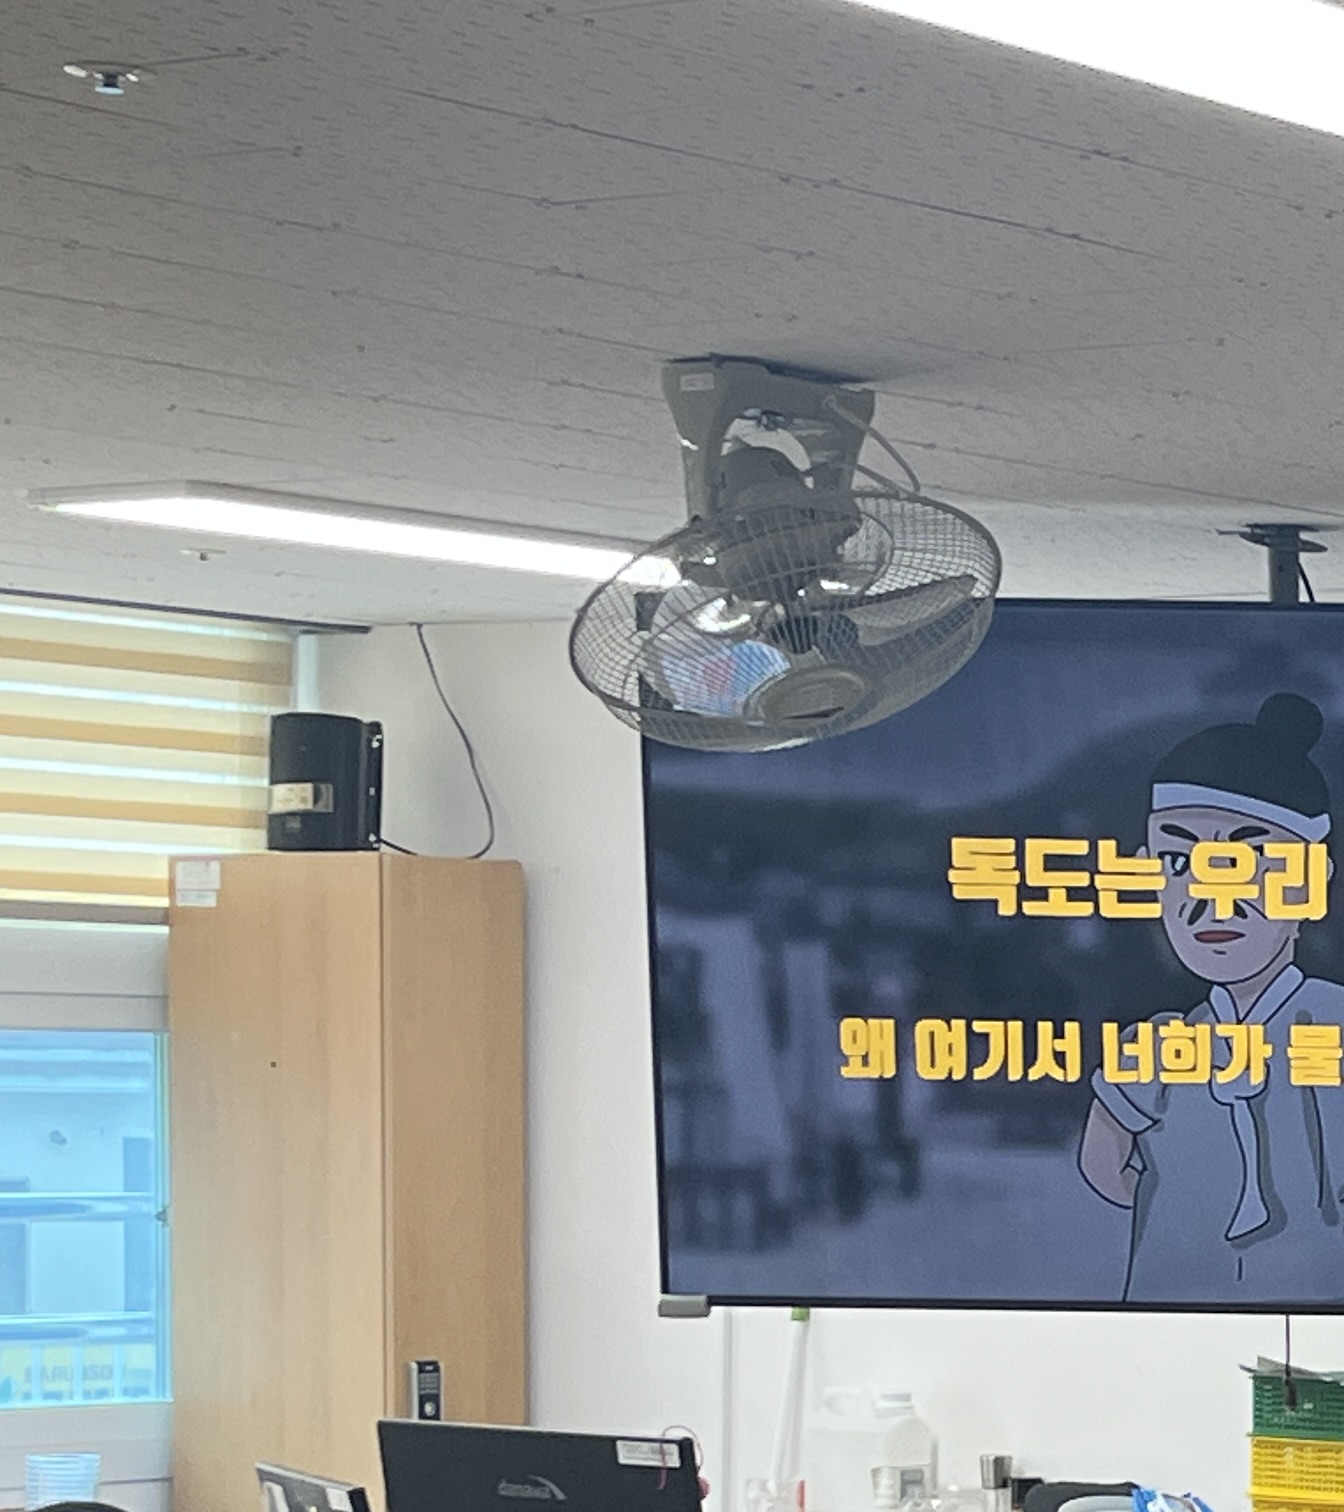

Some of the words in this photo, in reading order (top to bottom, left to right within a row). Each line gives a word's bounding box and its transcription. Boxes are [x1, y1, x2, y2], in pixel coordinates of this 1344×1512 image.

[947, 836, 1166, 920] 독도는
[1189, 841, 1329, 923] 우리
[838, 1016, 898, 1081] 왜
[914, 1016, 1082, 1085] 여기서
[1101, 1018, 1271, 1088] 너희가
